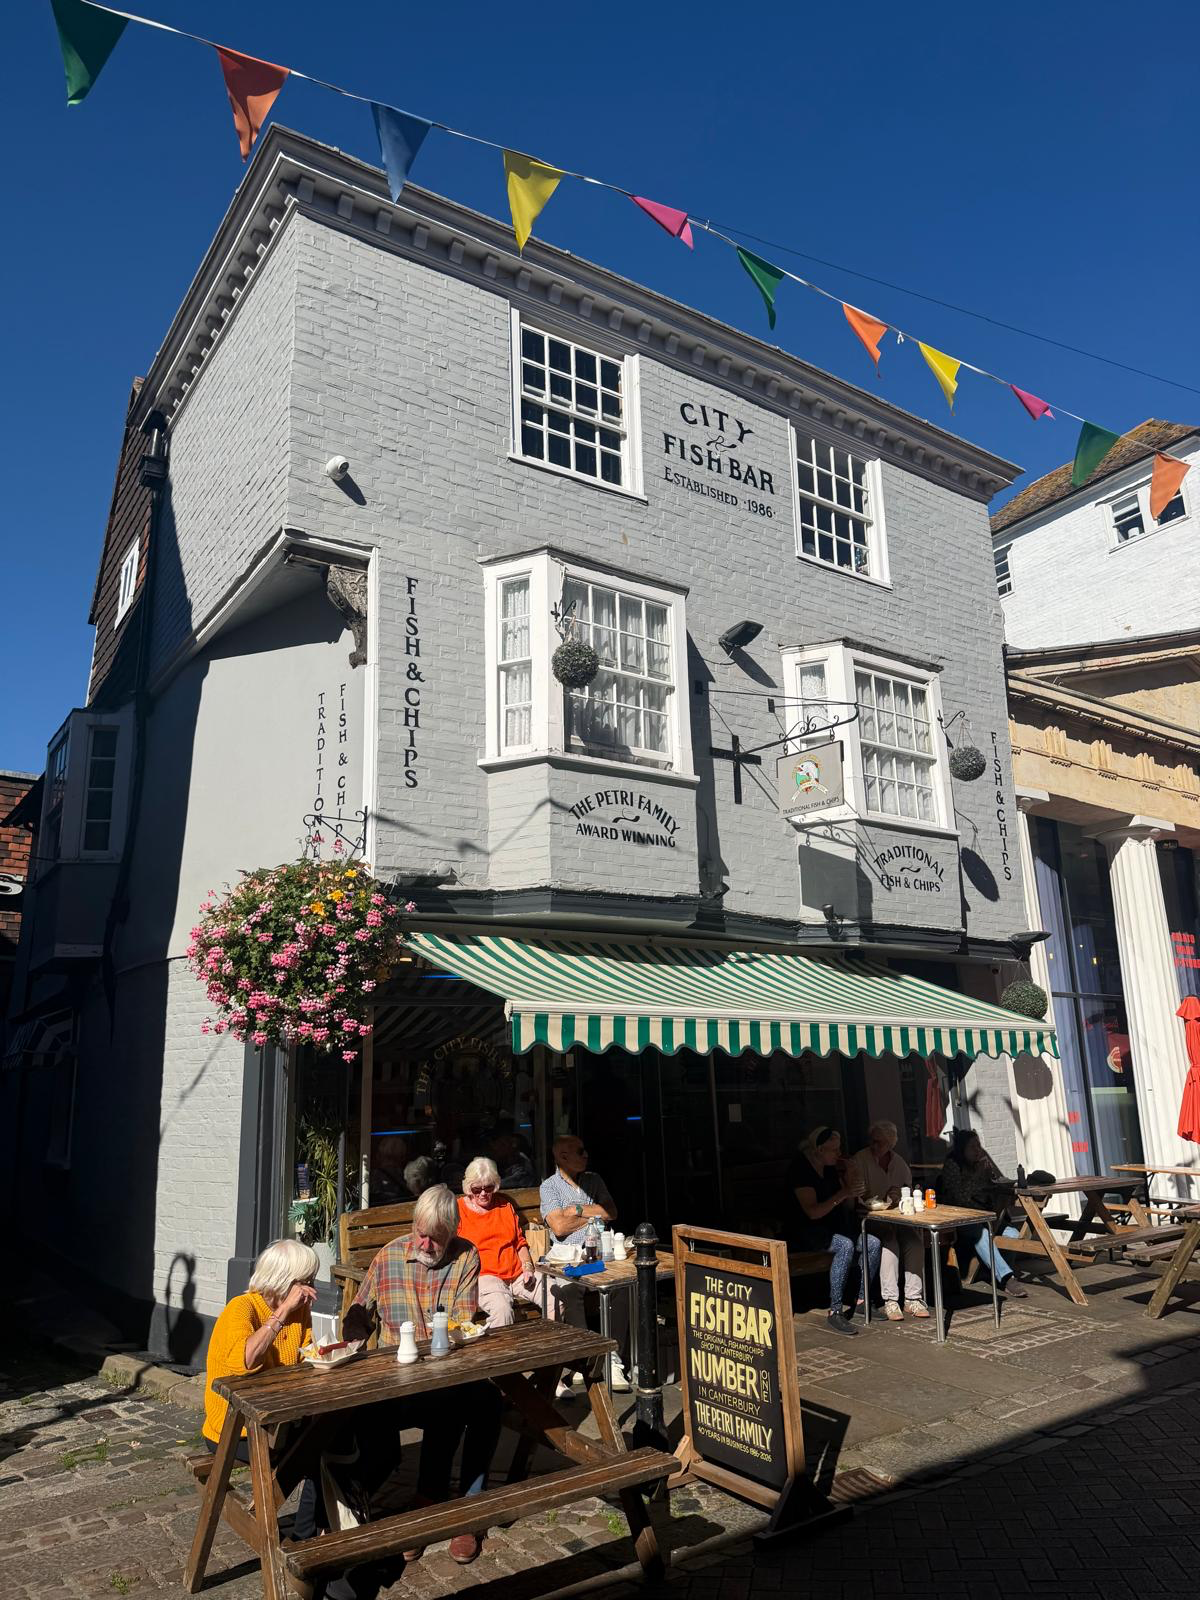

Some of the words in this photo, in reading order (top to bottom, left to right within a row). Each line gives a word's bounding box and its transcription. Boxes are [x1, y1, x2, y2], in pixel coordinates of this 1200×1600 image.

[680, 402, 754, 444] CITY
[663, 432, 722, 474] FISH
[729, 457, 775, 495] BAR
[664, 466, 738, 506] ESTABLISHED
[404, 576, 421, 657] FISH
[406, 662, 425, 683] &
[338, 683, 347, 743] FISH
[403, 688, 421, 788] CHIPS
[338, 752, 349, 766] &
[991, 731, 1003, 786] FISH
[334, 775, 347, 855] CHIP
[568, 795, 595, 820] THE
[595, 790, 634, 807] PETRI
[638, 794, 680, 835] FAMILY
[782, 803, 810, 815] TRADITIONAL
[811, 801, 821, 809] FISH
[826, 796, 840, 805] CHIPS
[996, 791, 1005, 805] &
[576, 823, 619, 840] AWARD
[622, 830, 676, 848] WINNING
[997, 809, 1012, 881] CHIPS
[873, 845, 944, 883] TRADITIONAL
[881, 874, 901, 888] FISH
[904, 877, 911, 889] &
[914, 879, 941, 892] CHIPS
[416, 1060, 434, 1095] THE
[434, 1035, 467, 1061] CITY
[470, 1038, 499, 1061] FISH
[704, 1276, 724, 1294] THE
[726, 1282, 753, 1301] CITY
[691, 1292, 729, 1335] FISH
[732, 1302, 773, 1347] BAR
[693, 1330, 703, 1340] THE
[704, 1333, 727, 1346] ORIGINAL
[701, 1341, 714, 1351] SHOP
[721, 1347, 754, 1364] CANTERBURY
[691, 1347, 760, 1399] NUMBER
[761, 1370, 769, 1403] ONE
[698, 1385, 707, 1398] IN
[708, 1389, 761, 1416] CANTERBURY
[694, 1400, 712, 1426] THE
[711, 1406, 734, 1435] PETRI
[735, 1416, 773, 1451] FAMILY
[705, 1429, 720, 1441] YEARS
[726, 1438, 749, 1453] BUSINESS
